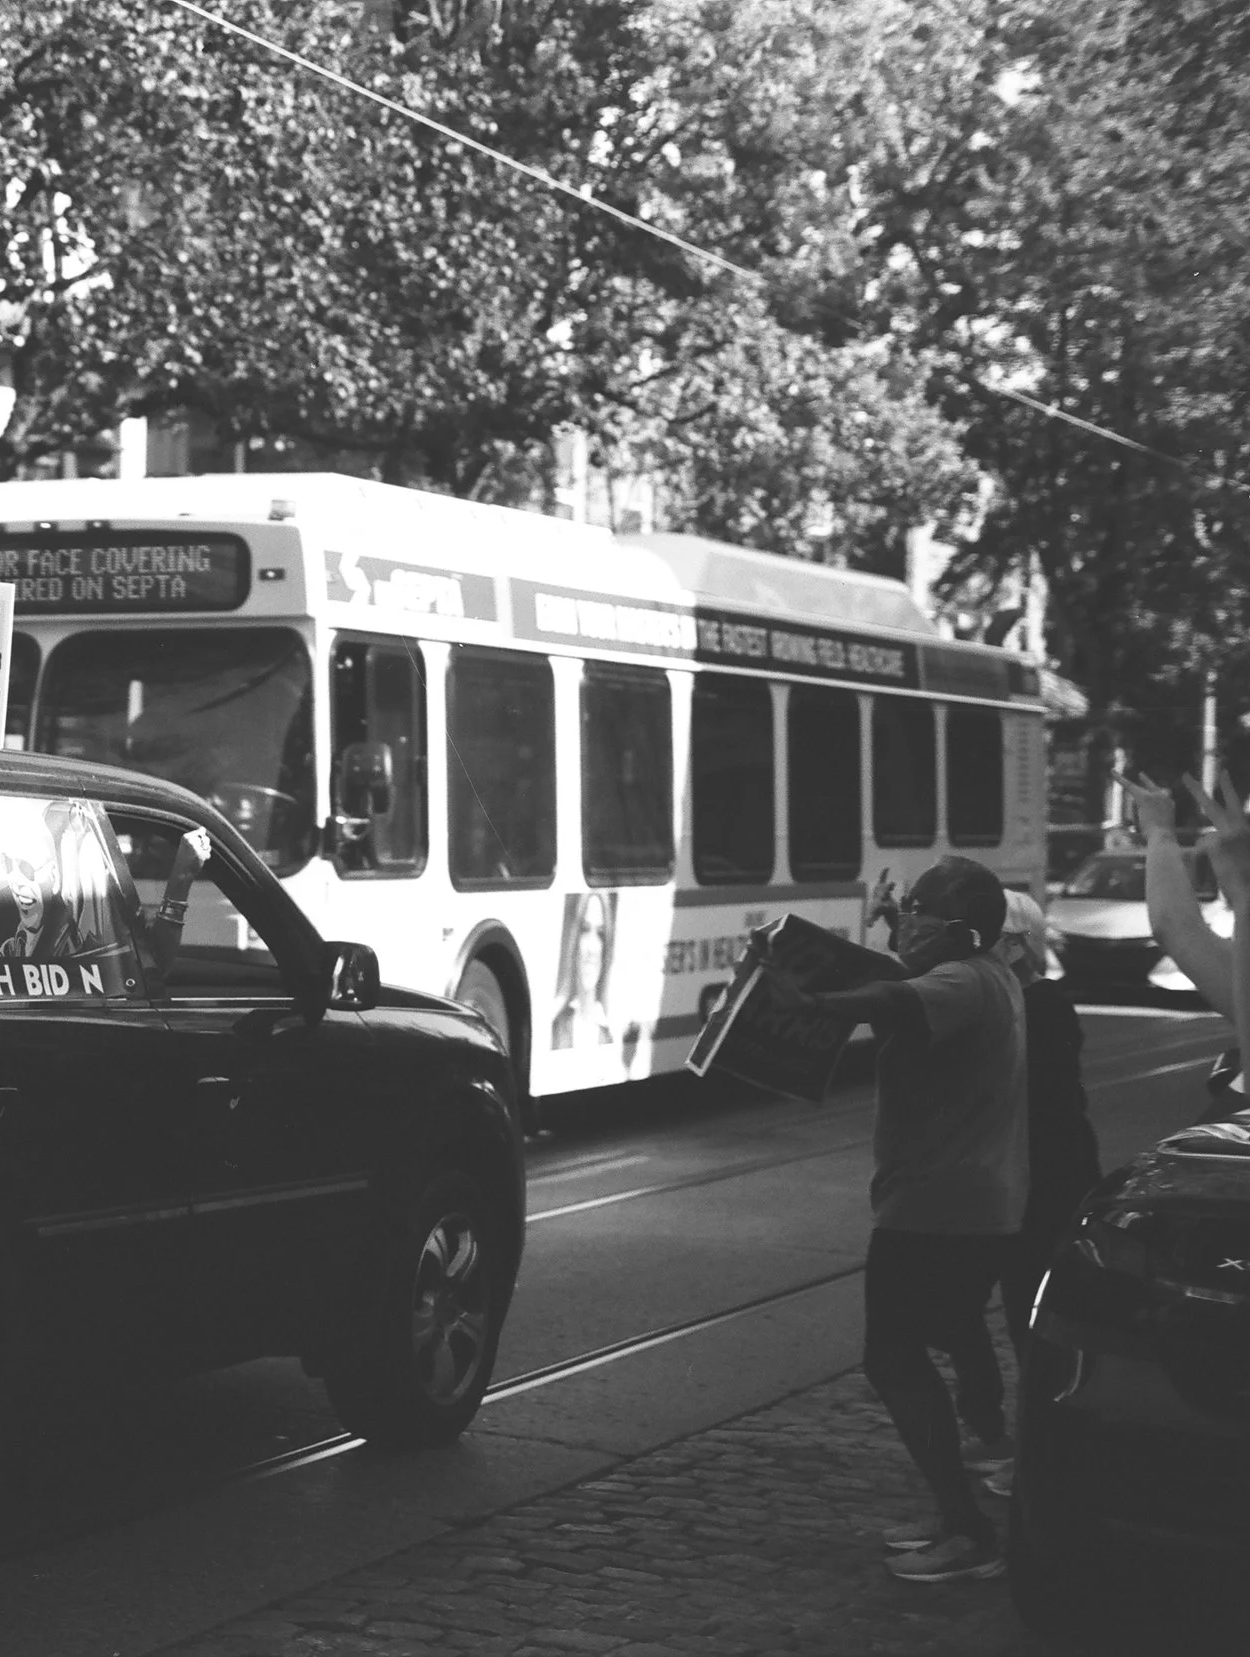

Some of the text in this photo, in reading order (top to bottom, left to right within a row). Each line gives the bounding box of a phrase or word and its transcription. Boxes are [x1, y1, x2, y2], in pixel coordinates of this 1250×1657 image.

[26, 549, 83, 575] FACE
[90, 545, 212, 573] COVERING
[71, 576, 103, 601] ON
[112, 574, 187, 600] SEPTA
[22, 964, 104, 995] BIDN
